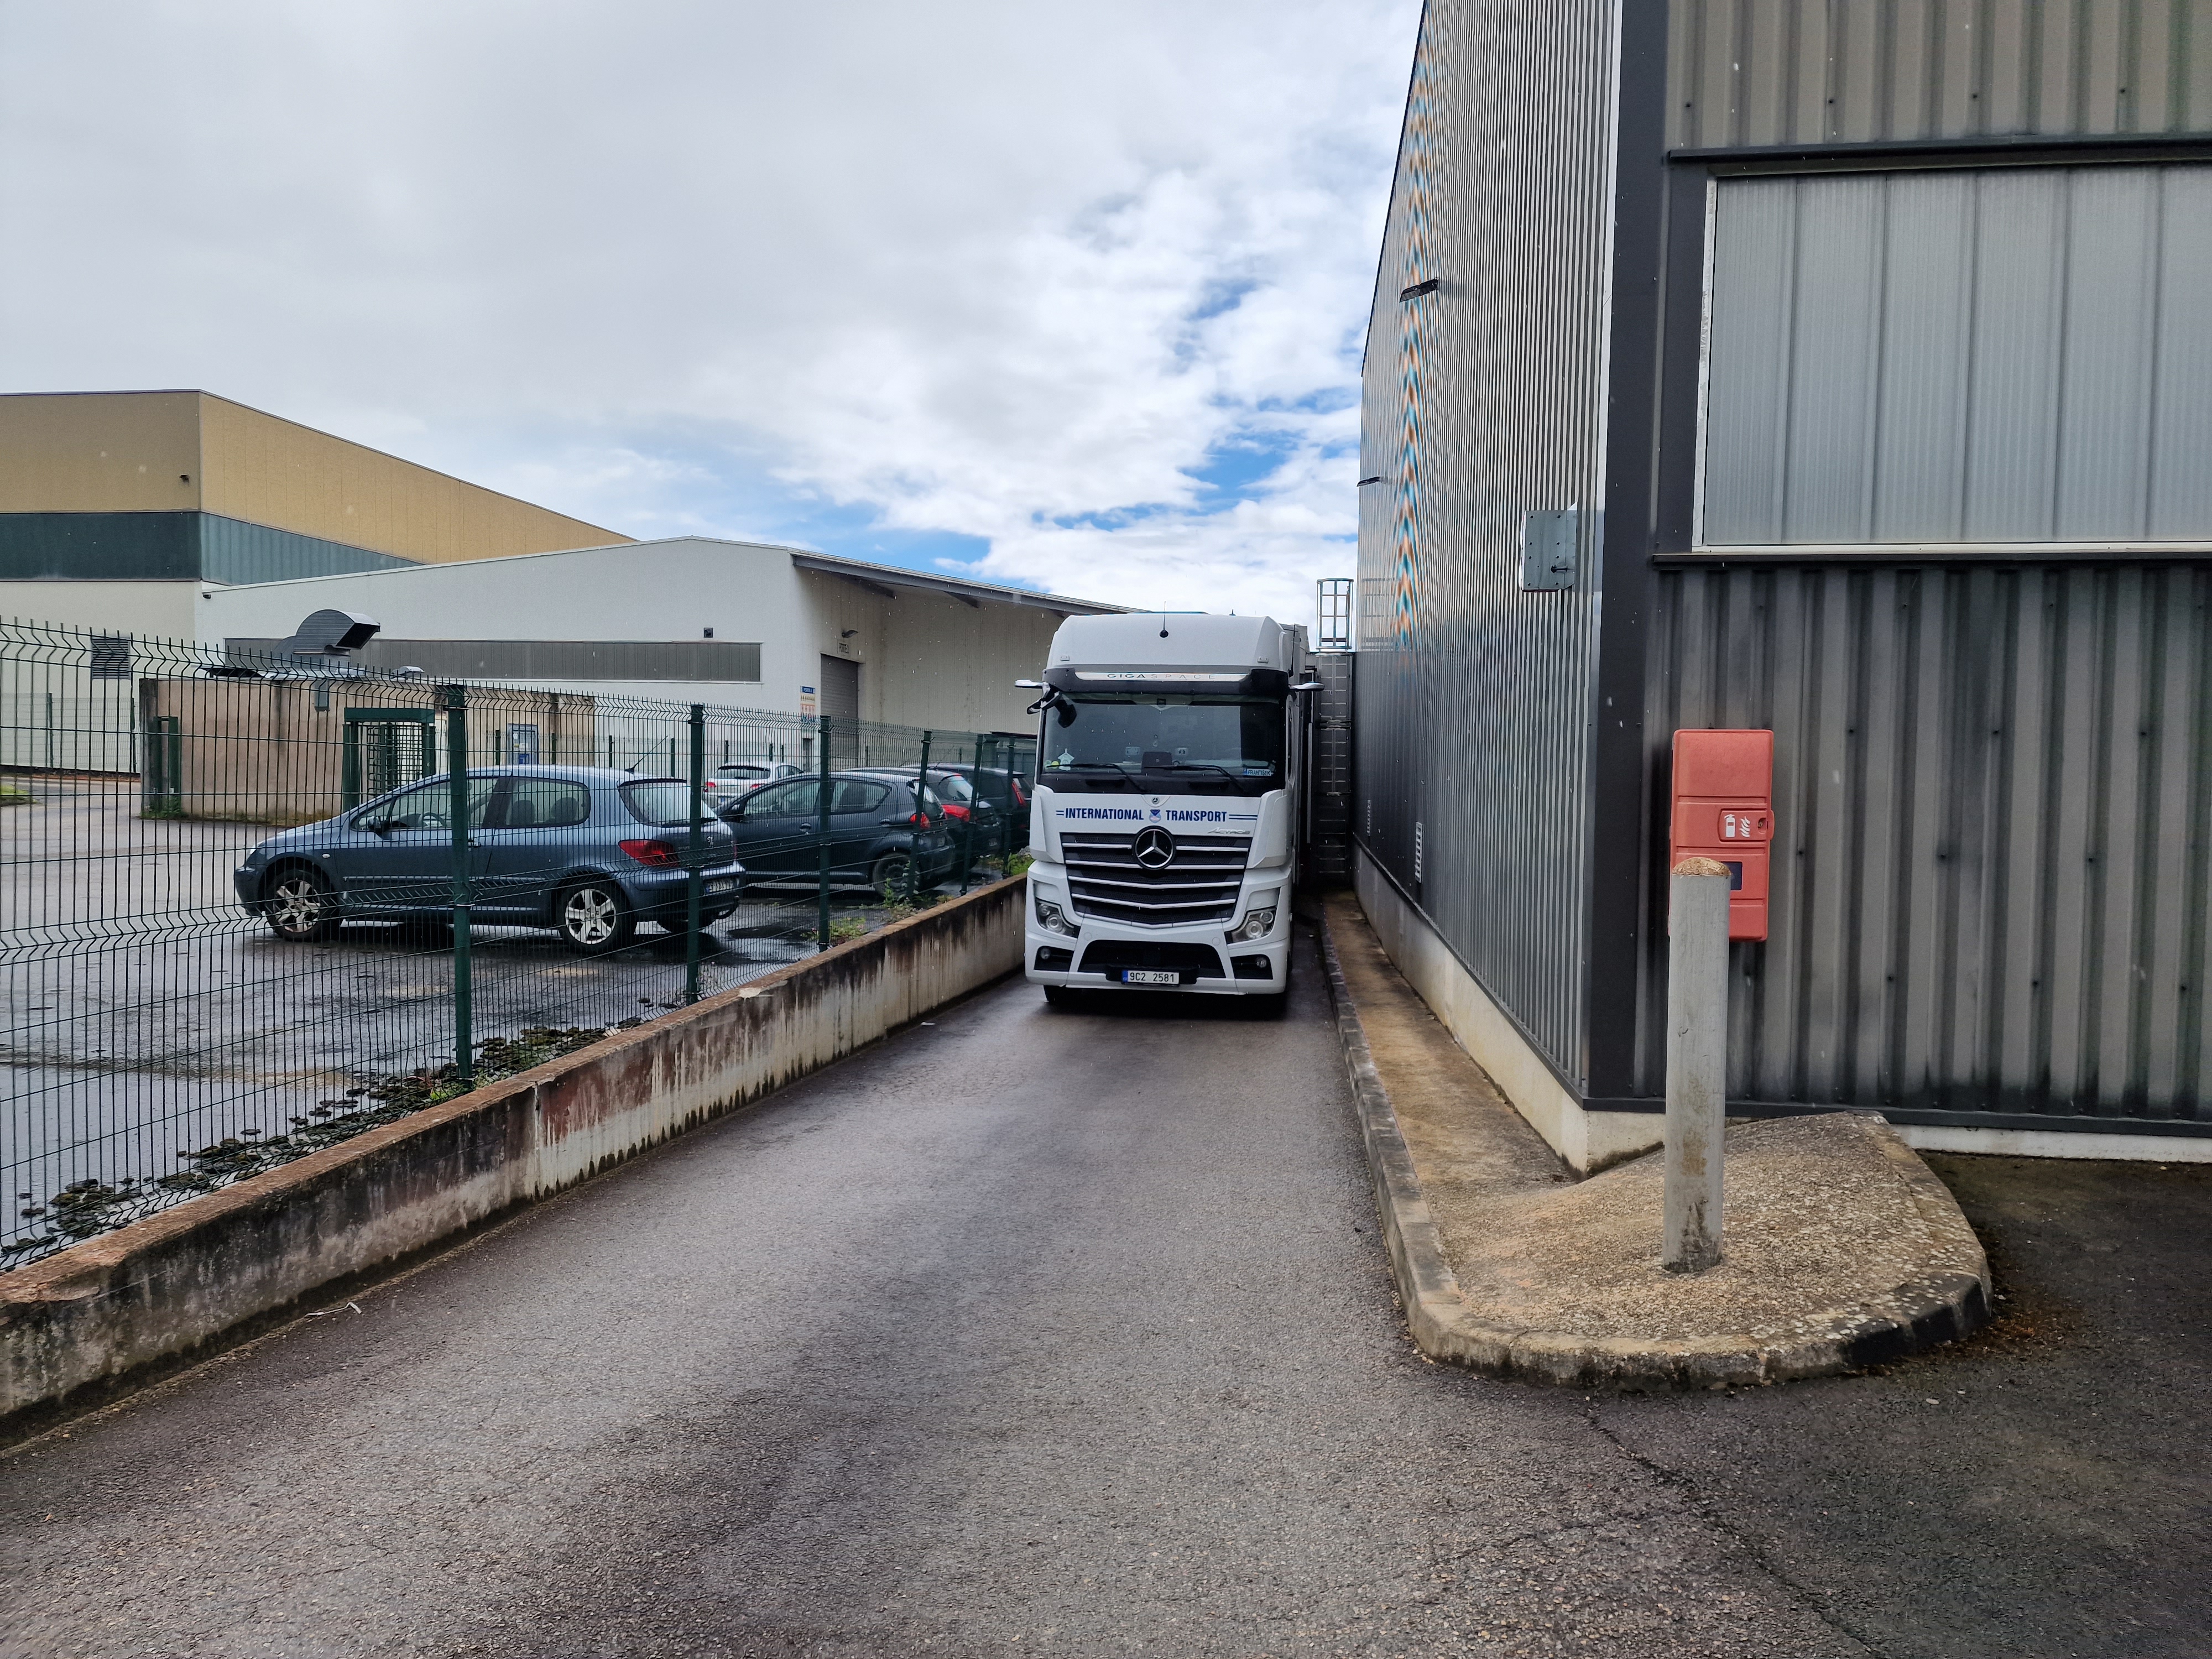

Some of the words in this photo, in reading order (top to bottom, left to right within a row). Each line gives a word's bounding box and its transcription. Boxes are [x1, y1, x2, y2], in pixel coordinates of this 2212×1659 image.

[1065, 807, 1144, 820] INTERNATIONAL
[1165, 810, 1227, 822] TRANSPORT
[1130, 972, 1146, 981] 9C2
[1152, 973, 1175, 983] 2581
